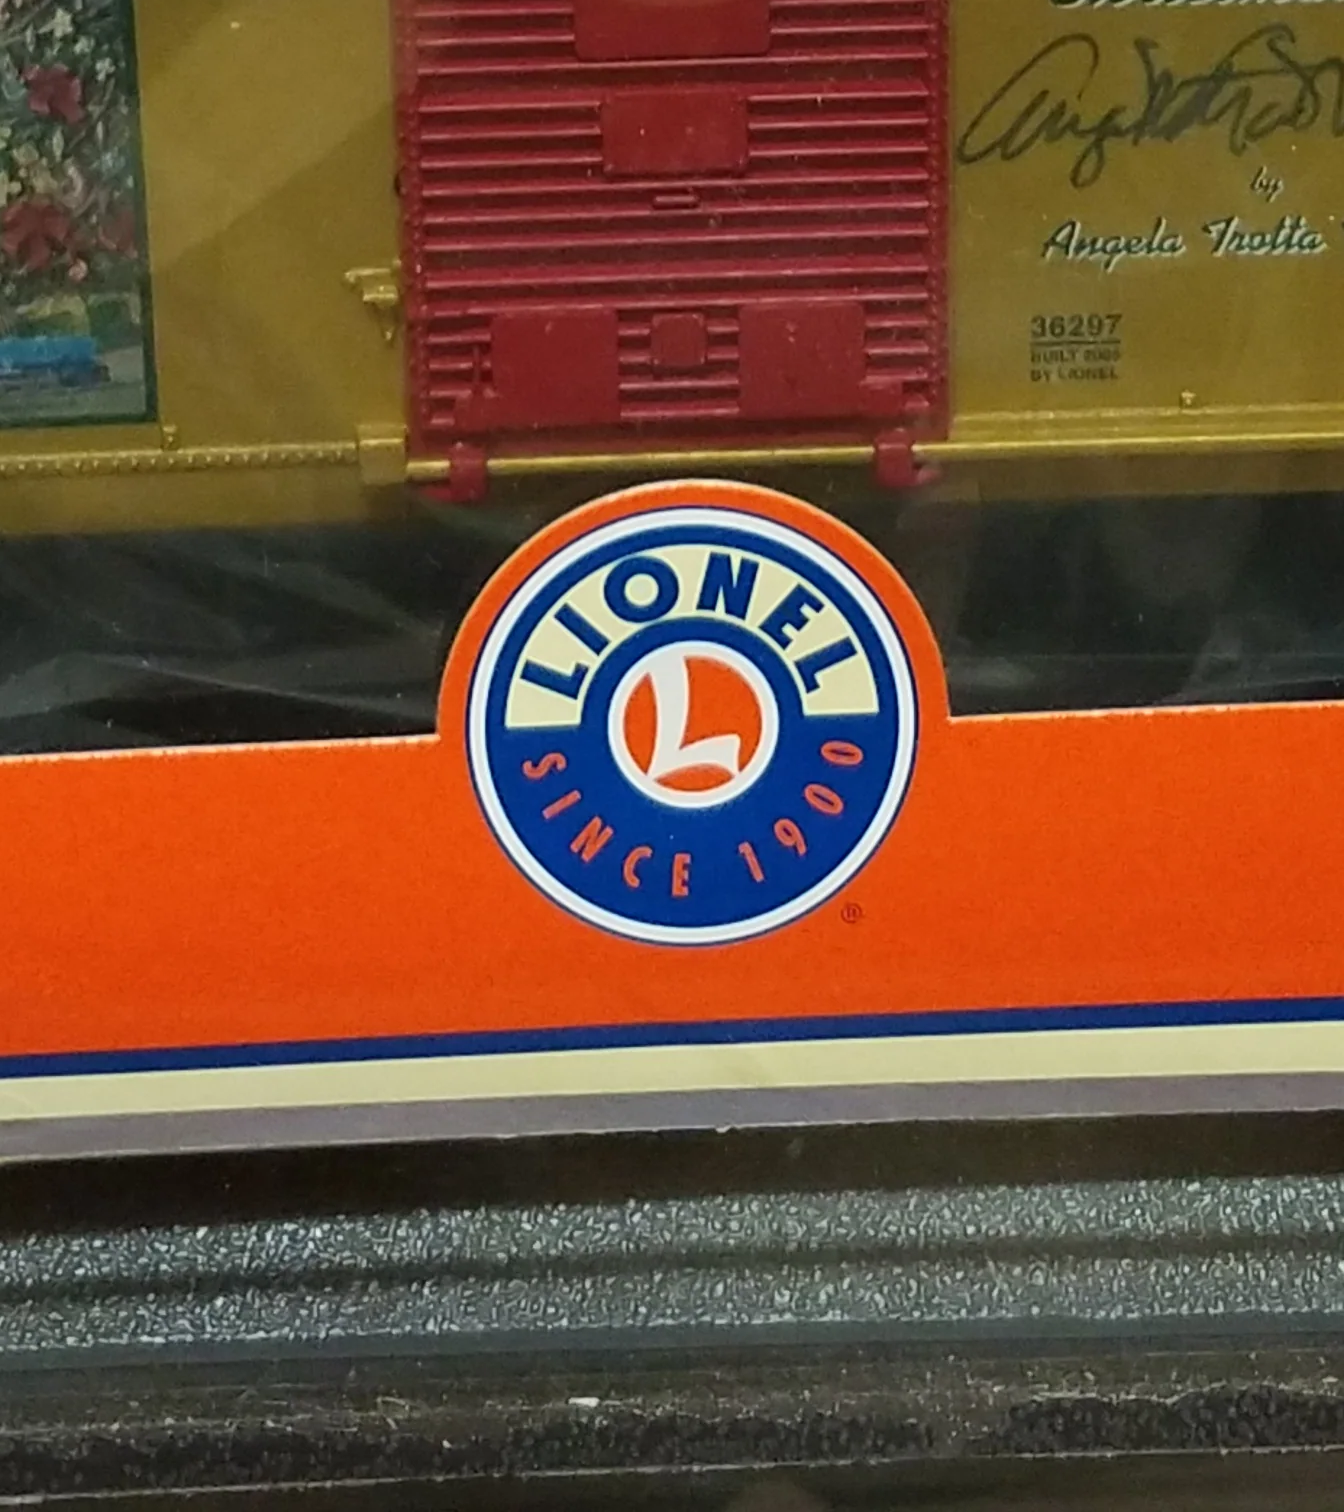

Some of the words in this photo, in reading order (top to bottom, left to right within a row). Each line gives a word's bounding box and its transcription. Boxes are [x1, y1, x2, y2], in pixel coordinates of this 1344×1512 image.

[1249, 165, 1285, 204] by
[1041, 215, 1187, 273] Angela
[1201, 214, 1327, 258] Trotta
[519, 551, 859, 702] LIONEL
[522, 751, 692, 897] SINCE
[738, 740, 864, 883] 1900
